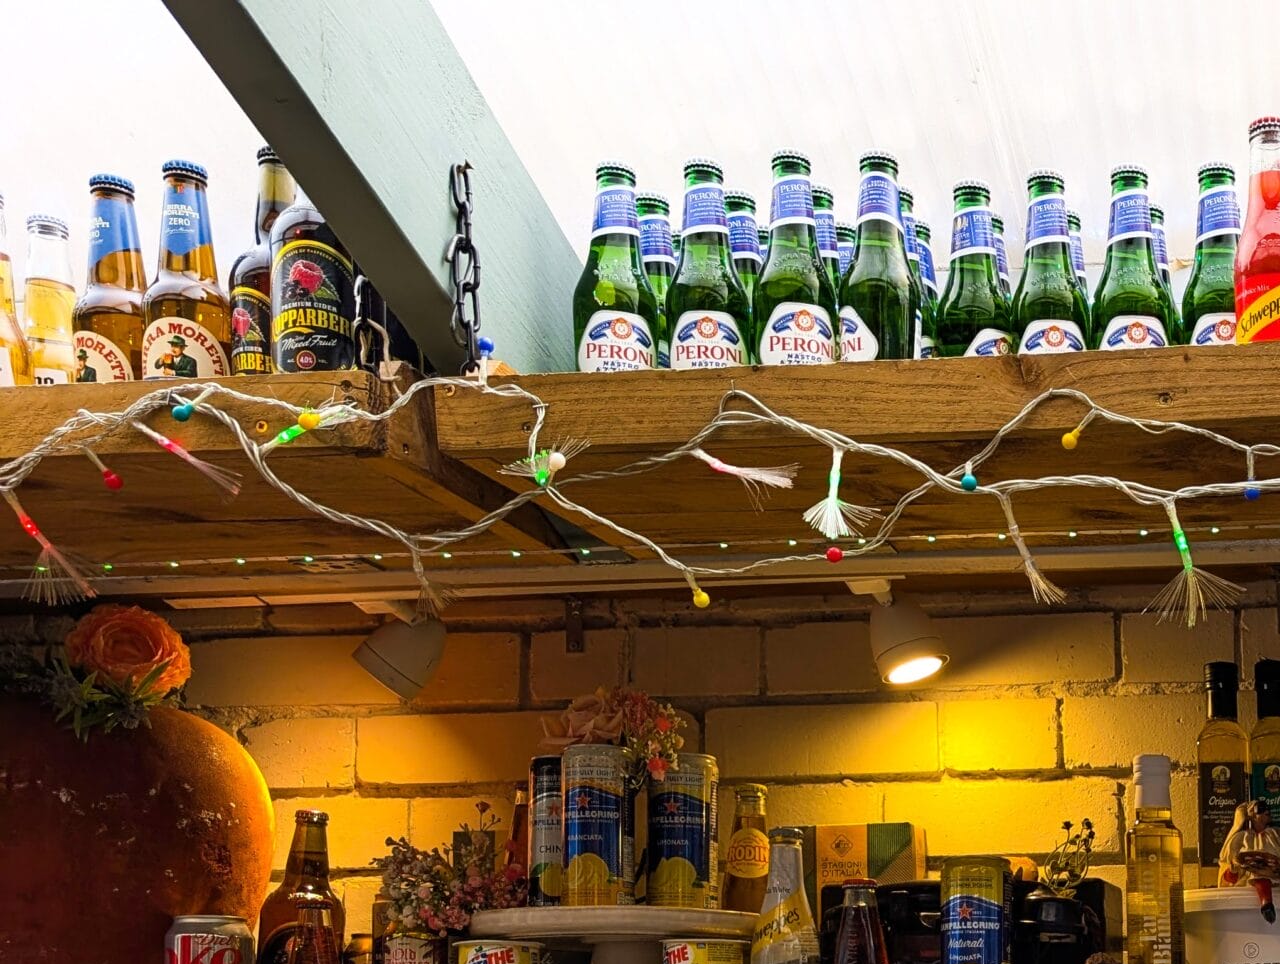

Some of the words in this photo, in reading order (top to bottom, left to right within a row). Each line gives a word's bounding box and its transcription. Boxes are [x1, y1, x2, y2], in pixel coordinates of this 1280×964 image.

[168, 218, 191, 226] ZERO
[272, 308, 353, 343] OPPARBER
[168, 322, 225, 377] MORETT
[585, 342, 654, 367] PERONI
[676, 343, 743, 364] PERONI
[769, 335, 835, 359] PERONI
[77, 336, 126, 381] MORETT
[603, 360, 639, 370] NASTRO
[1208, 796, 1237, 808] Origano
[540, 845, 562, 853] CHIN
[728, 846, 770, 861] RODIN
[821, 861, 863, 869] STAGIONI
[941, 920, 1000, 932] ANPELLEGRINO
